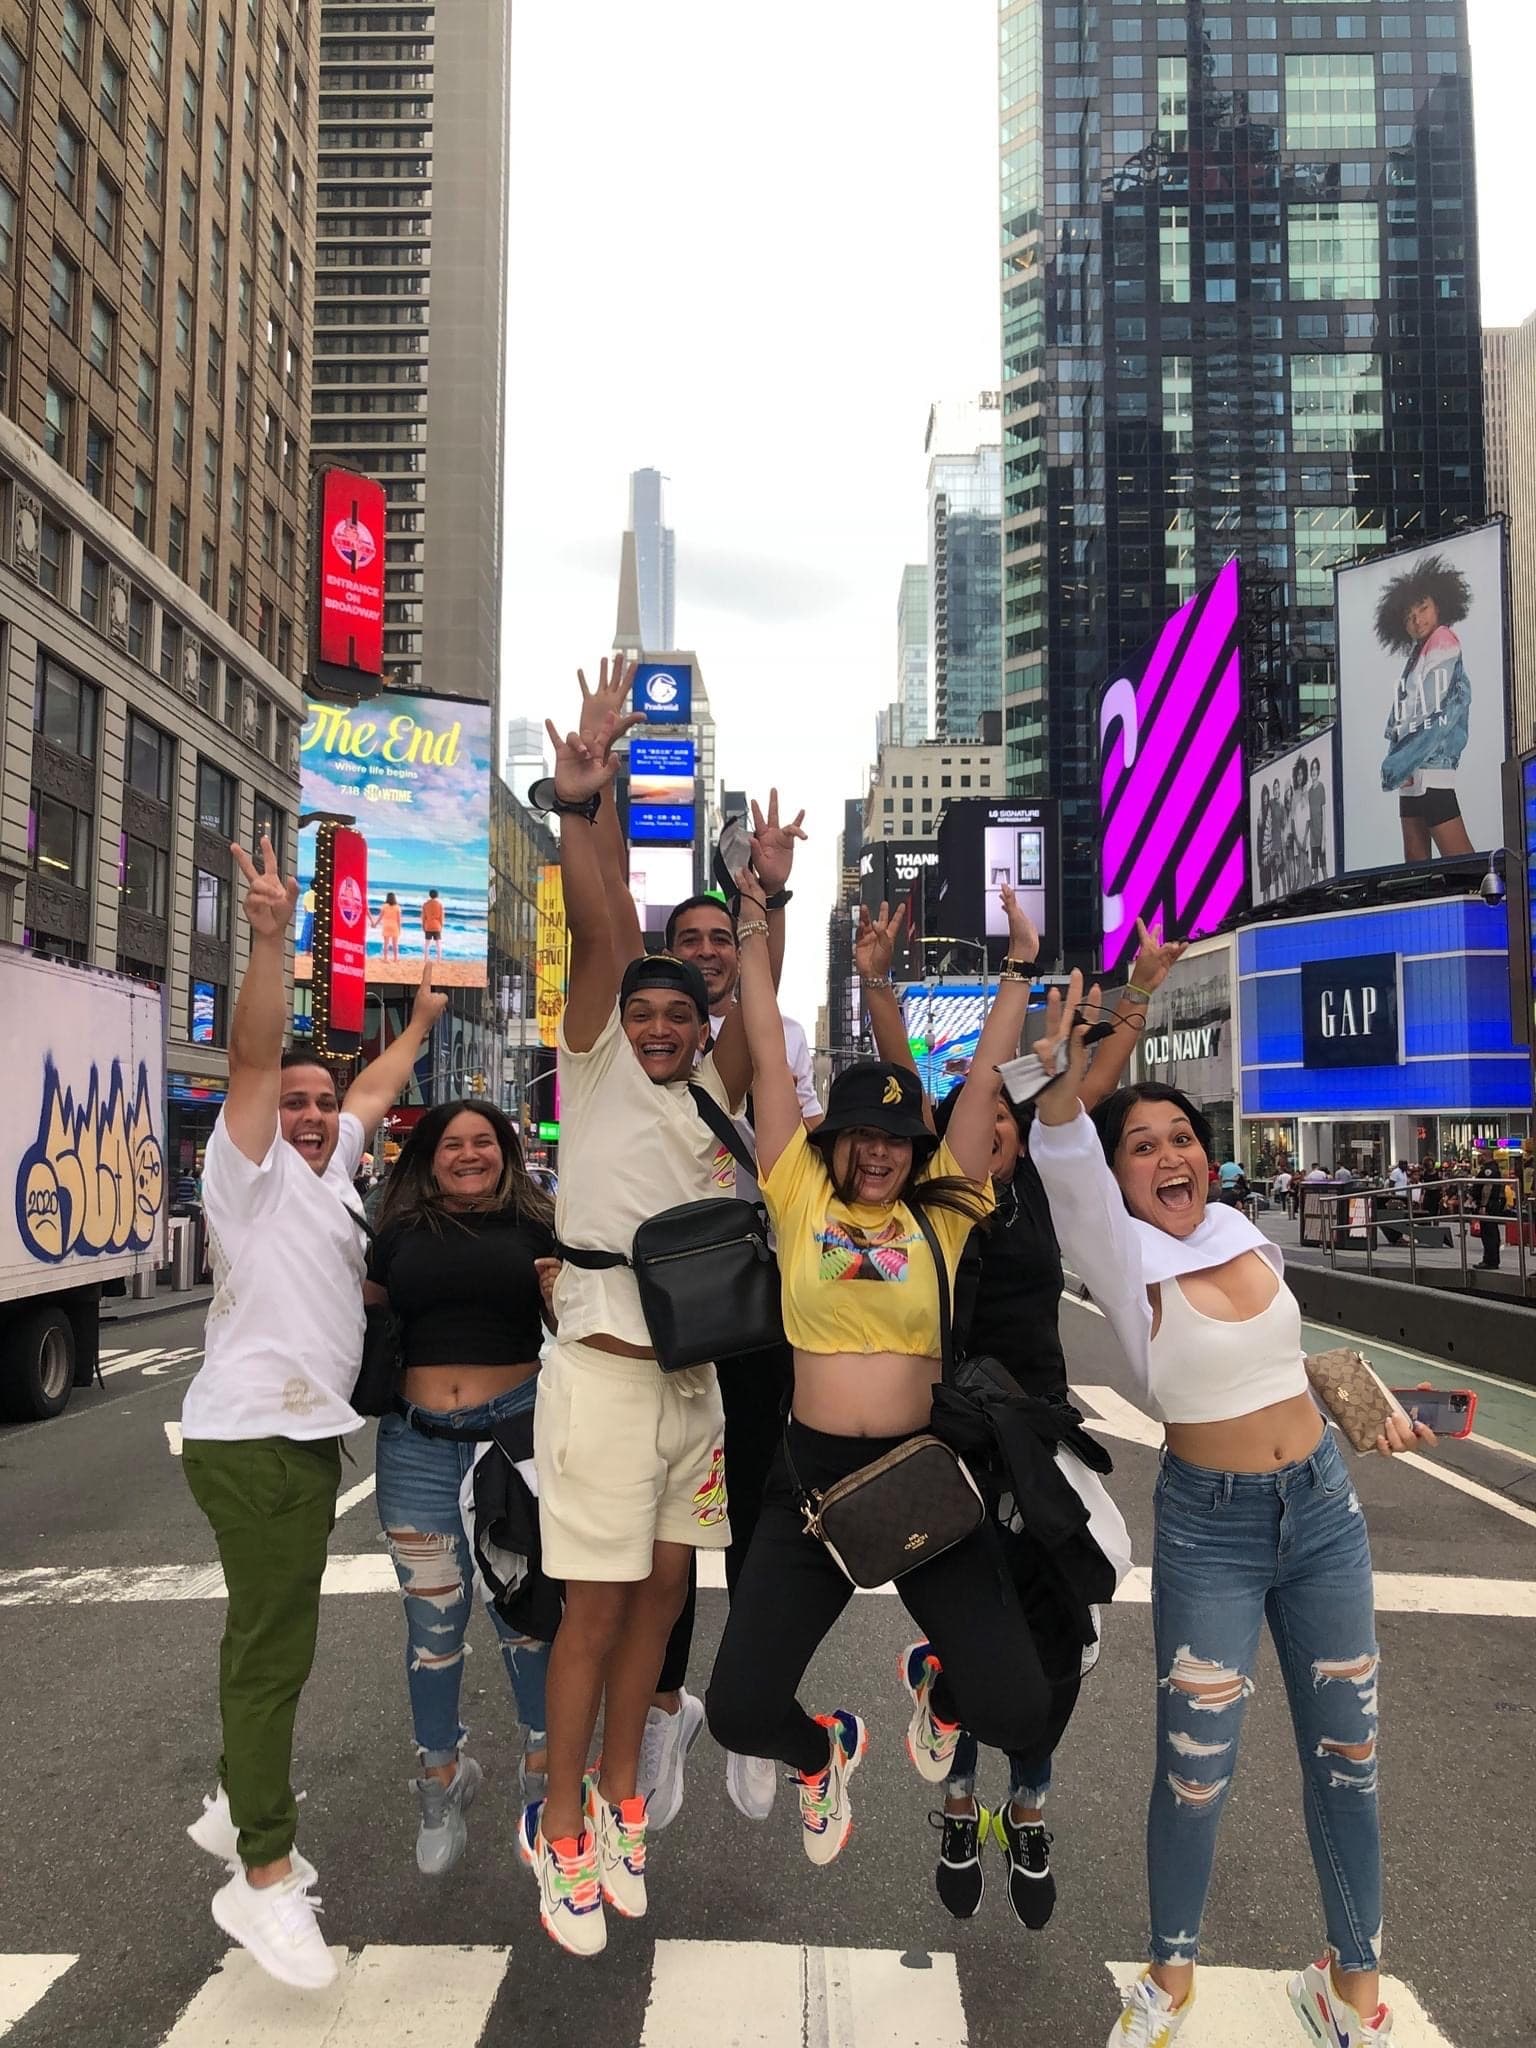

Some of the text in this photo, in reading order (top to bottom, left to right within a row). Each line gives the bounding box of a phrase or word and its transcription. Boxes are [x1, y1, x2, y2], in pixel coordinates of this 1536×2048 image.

[326, 574, 380, 597] ENTRANCE
[324, 597, 380, 621] BROADWAY
[345, 592, 361, 603] ON
[1393, 667, 1448, 721] GAP
[644, 702, 679, 712] Prudential
[301, 704, 462, 767] The End
[1394, 714, 1447, 736] TEEN
[335, 761, 418, 780] Where life begins
[364, 783, 413, 803] SHOWTIME
[988, 810, 1040, 818] LG SIGNATURE
[1321, 986, 1377, 1038] GAP
[1145, 1028, 1212, 1065] OLD NAVY
[28, 1189, 59, 1218] 2020
